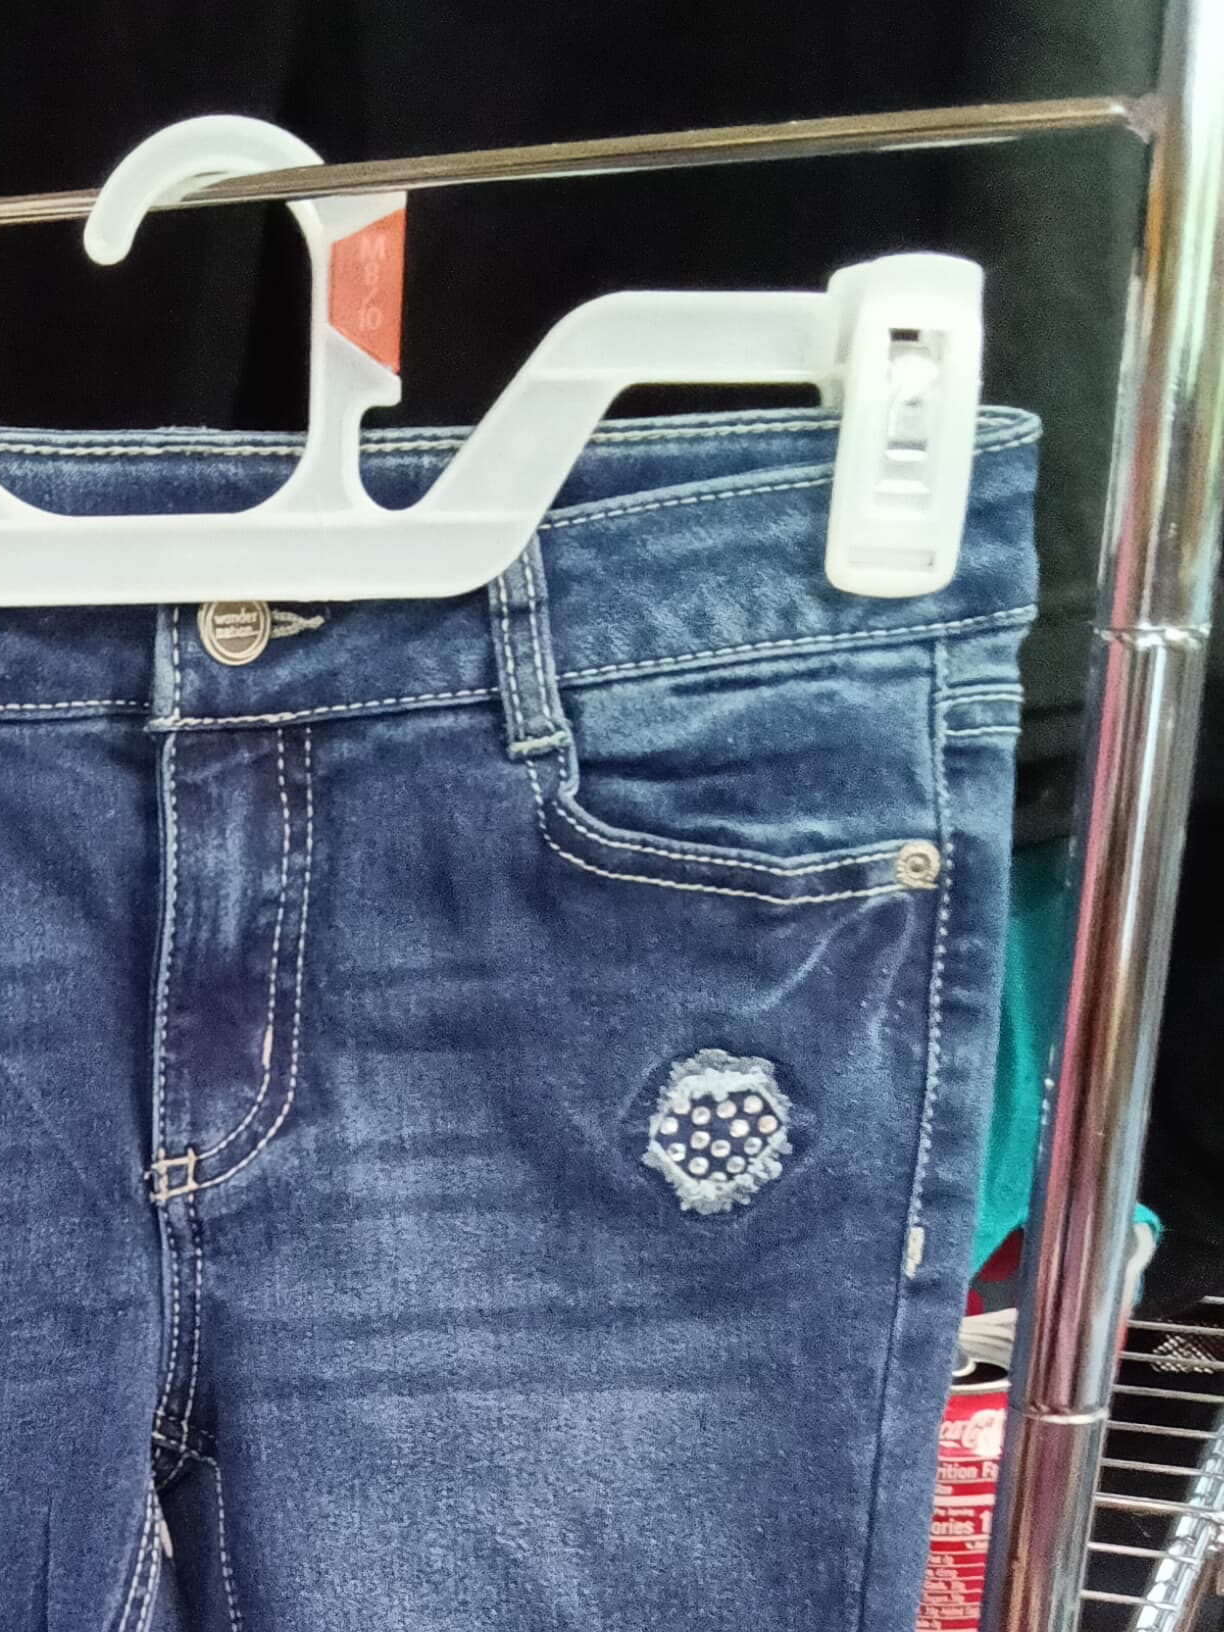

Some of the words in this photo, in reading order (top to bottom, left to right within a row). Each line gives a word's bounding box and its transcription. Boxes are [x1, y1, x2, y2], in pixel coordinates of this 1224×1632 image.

[359, 233, 387, 261] M
[936, 1461, 978, 1479] rition
[931, 1517, 975, 1535] ories
